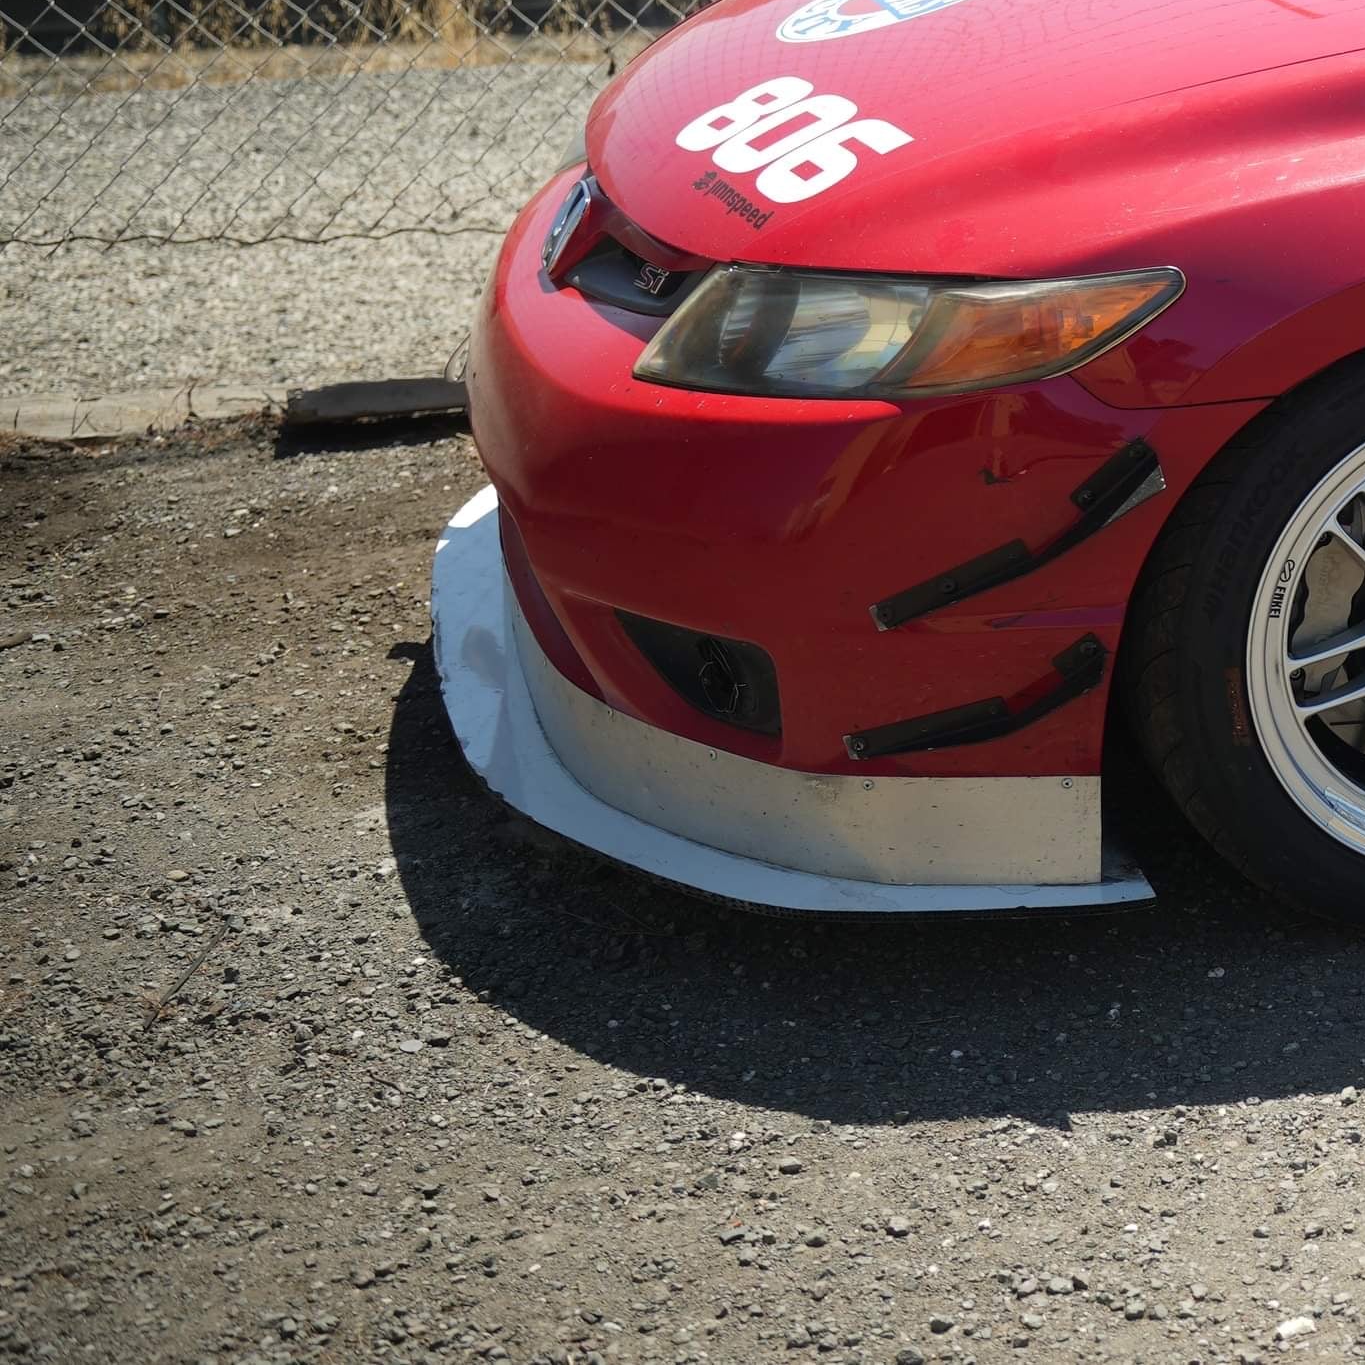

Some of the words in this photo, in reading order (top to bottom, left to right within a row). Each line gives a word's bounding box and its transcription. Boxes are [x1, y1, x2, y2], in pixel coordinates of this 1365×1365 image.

[675, 76, 915, 204] 806
[633, 262, 670, 295] Si
[1269, 586, 1287, 619] ENKEI
